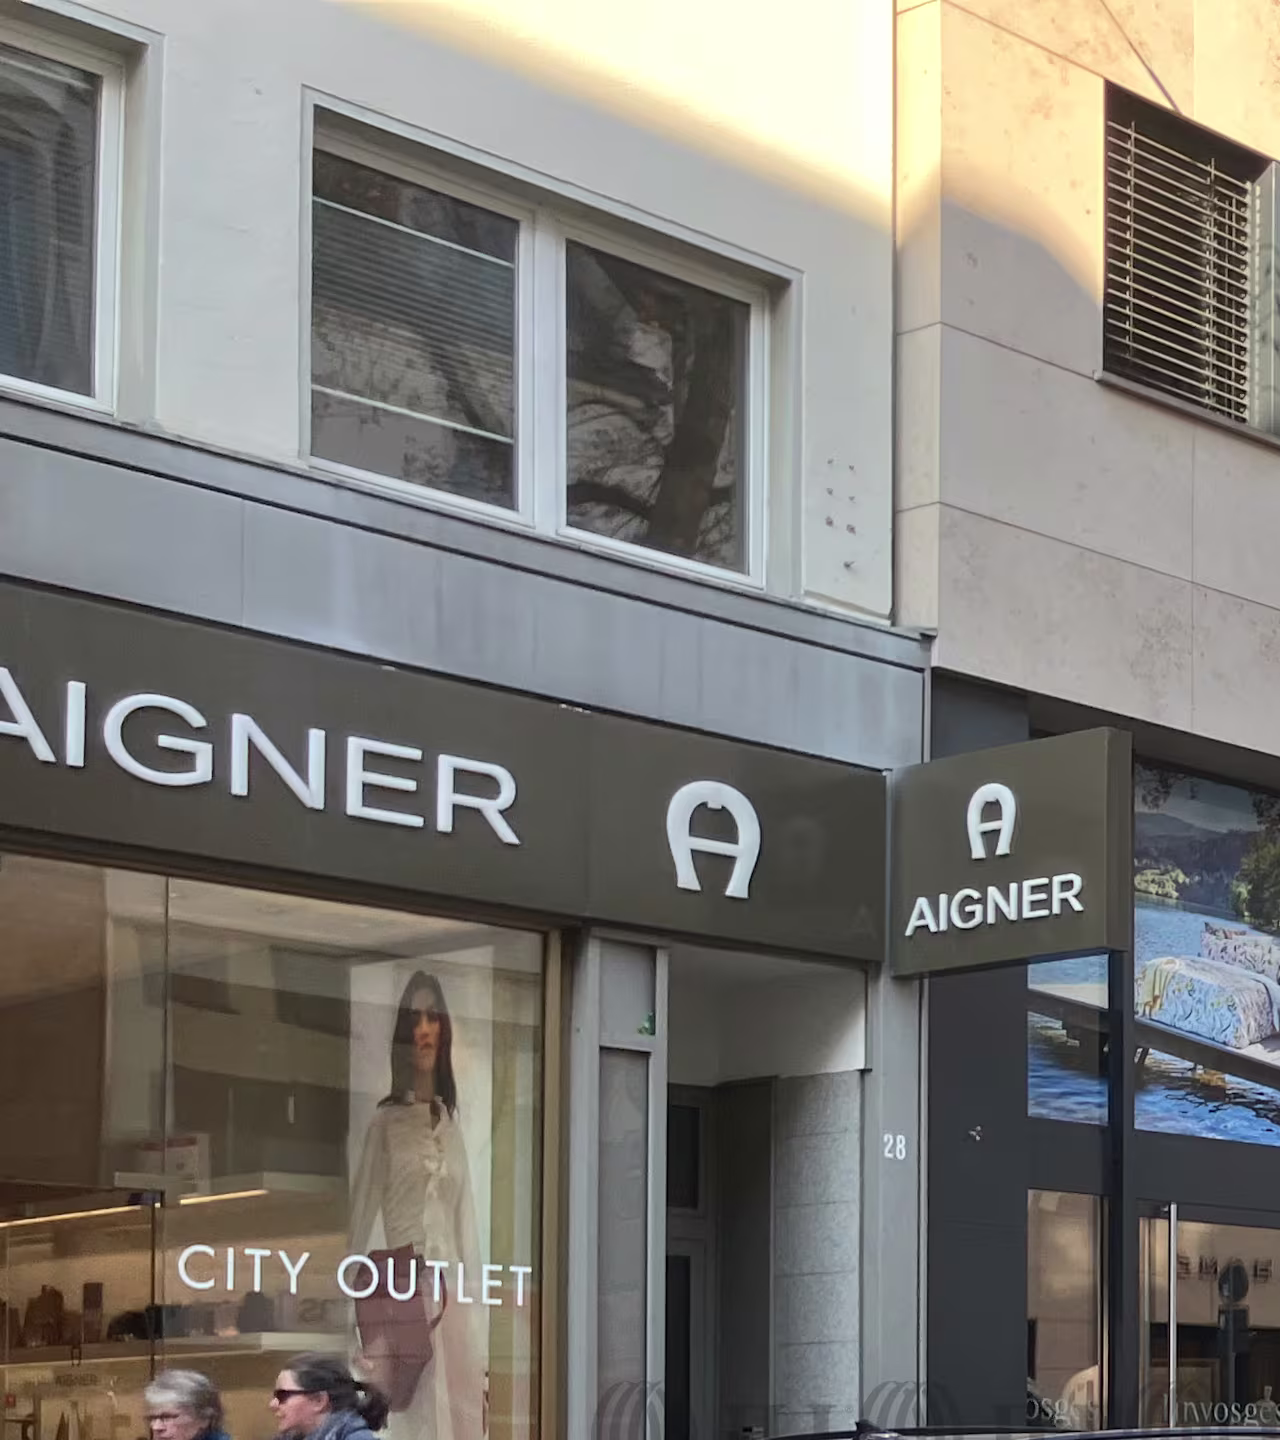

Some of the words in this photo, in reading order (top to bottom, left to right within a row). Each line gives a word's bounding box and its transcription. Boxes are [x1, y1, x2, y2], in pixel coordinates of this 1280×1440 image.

[0, 665, 521, 846] AIGNER
[905, 872, 1084, 937] AIGNER
[883, 1134, 907, 1161] 28
[177, 1243, 311, 1295] CITY
[336, 1252, 533, 1307] OUTLET
